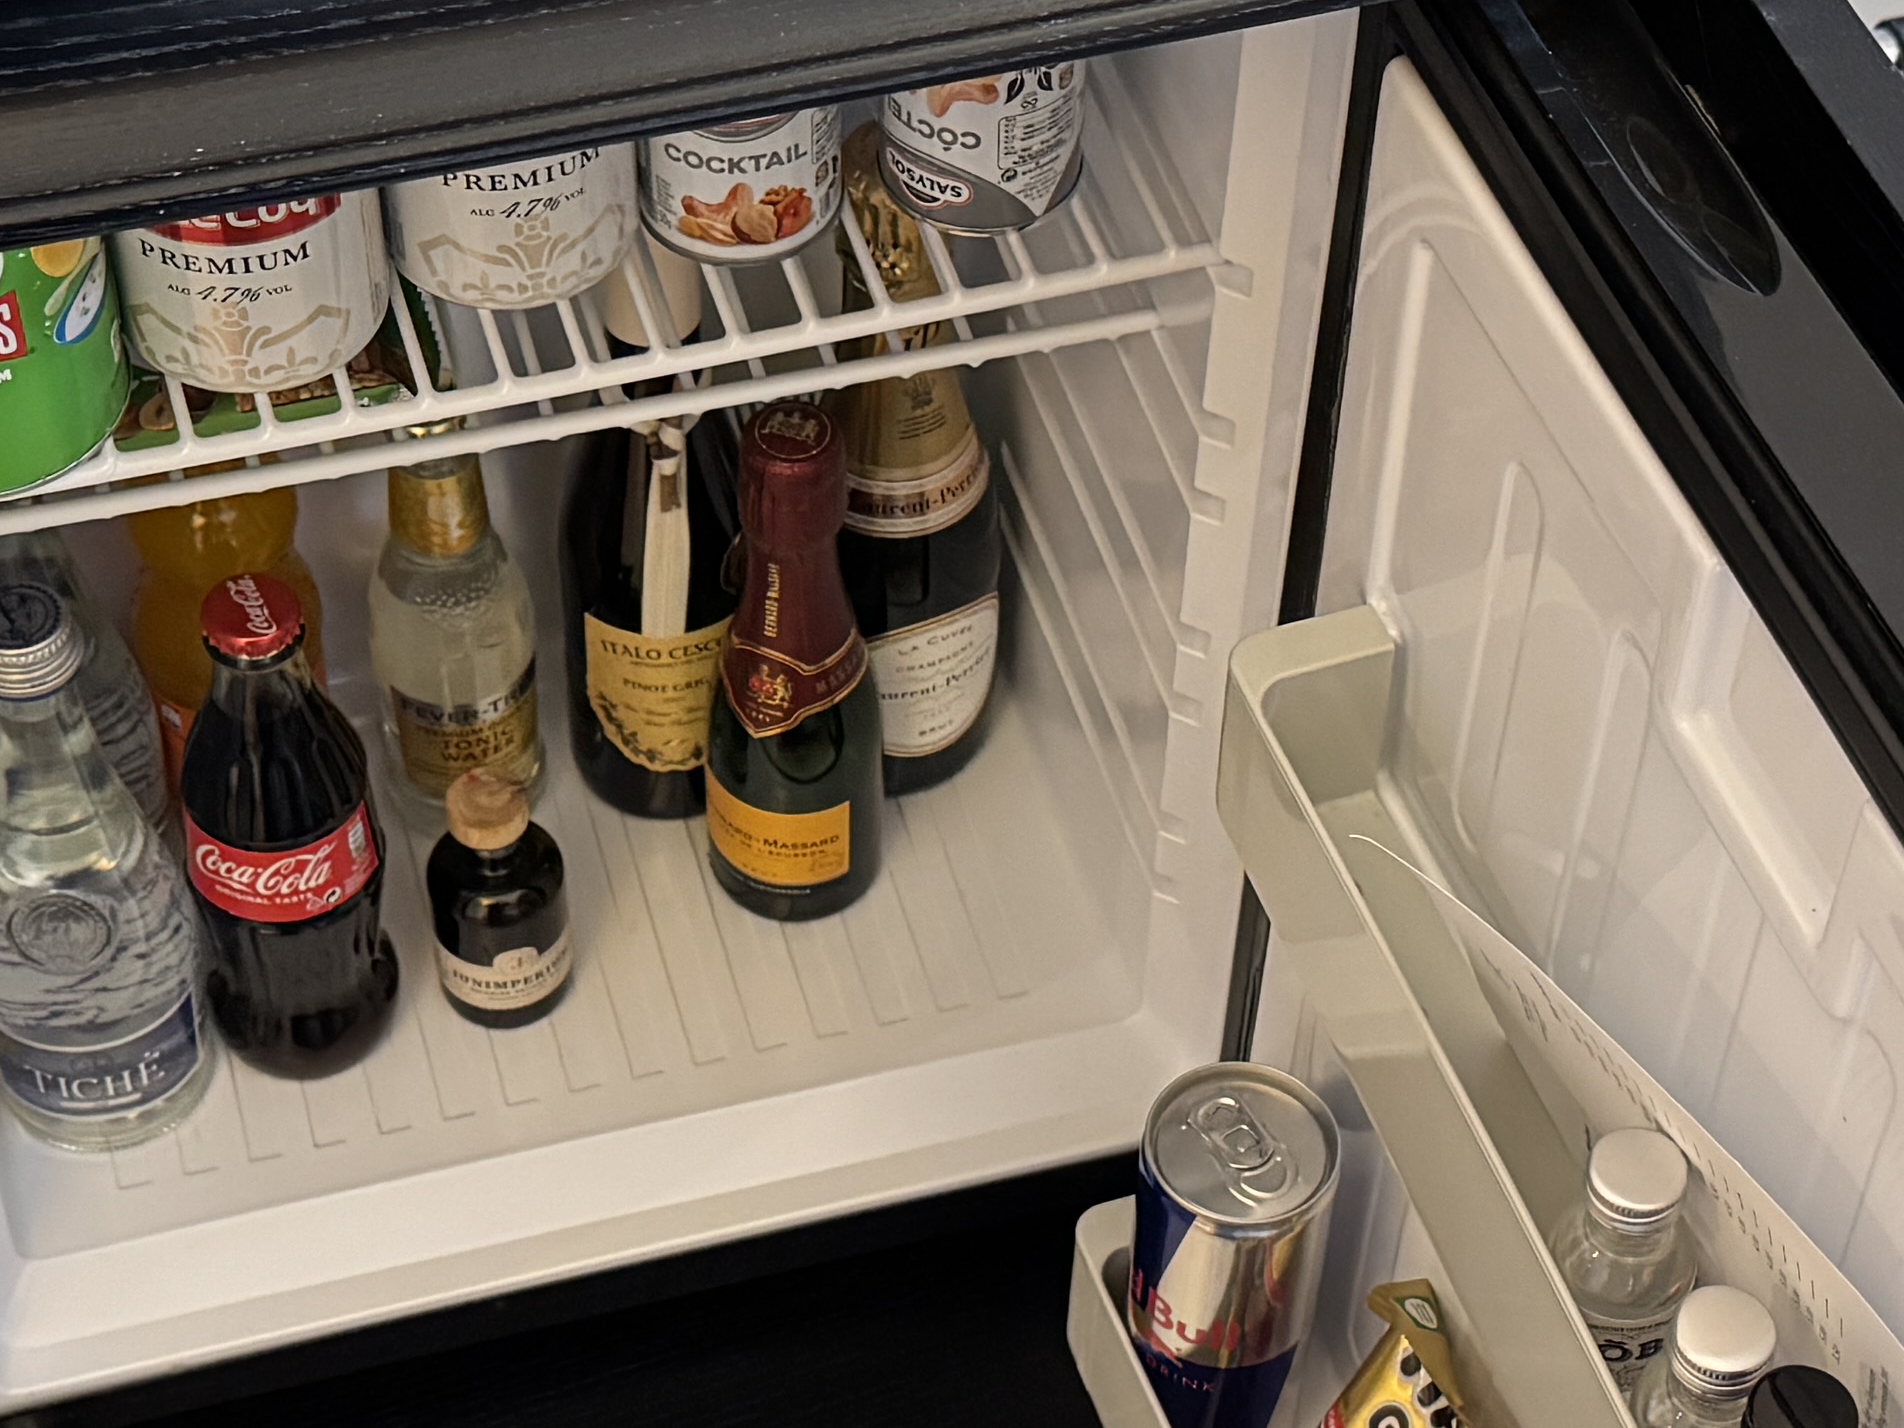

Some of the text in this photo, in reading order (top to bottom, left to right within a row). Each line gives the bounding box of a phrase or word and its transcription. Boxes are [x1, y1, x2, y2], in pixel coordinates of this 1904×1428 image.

[442, 146, 600, 192] PREMIUM
[664, 142, 808, 175] COCKTAIL
[889, 149, 963, 198] SALYSOL
[470, 186, 586, 218] ALC 4.7% VOL
[137, 237, 311, 275] PREMIUM
[167, 283, 293, 305] ALC 4.7% VOL
[600, 639, 662, 661] ITALO
[440, 736, 515, 763] WATER
[442, 727, 511, 750] TONIC
[196, 840, 337, 896] Coca-Cola
[1148, 1286, 1241, 1352] Bull
